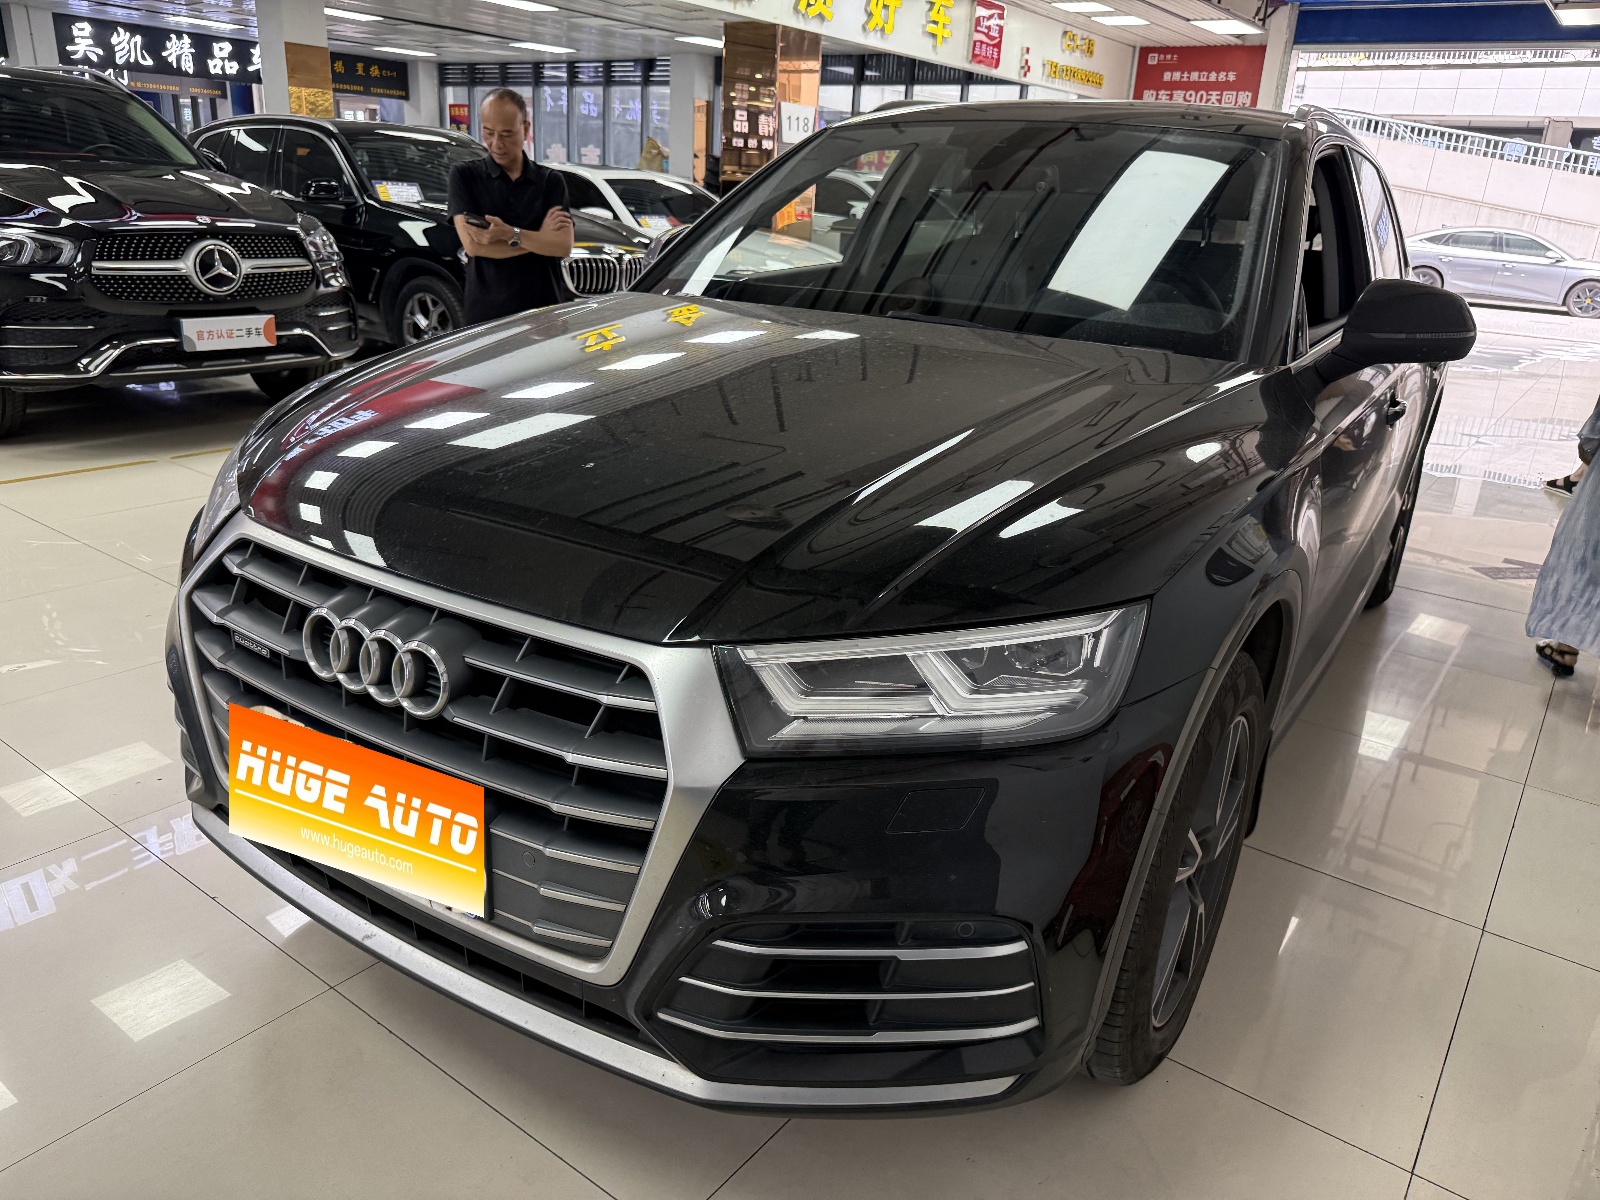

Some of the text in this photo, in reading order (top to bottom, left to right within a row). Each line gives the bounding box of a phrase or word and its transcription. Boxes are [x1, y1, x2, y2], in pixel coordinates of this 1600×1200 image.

[1065, 31, 1095, 58] C1-18
[786, 115, 810, 133] 118
[196, 326, 263, 342] 官方认证二手车
